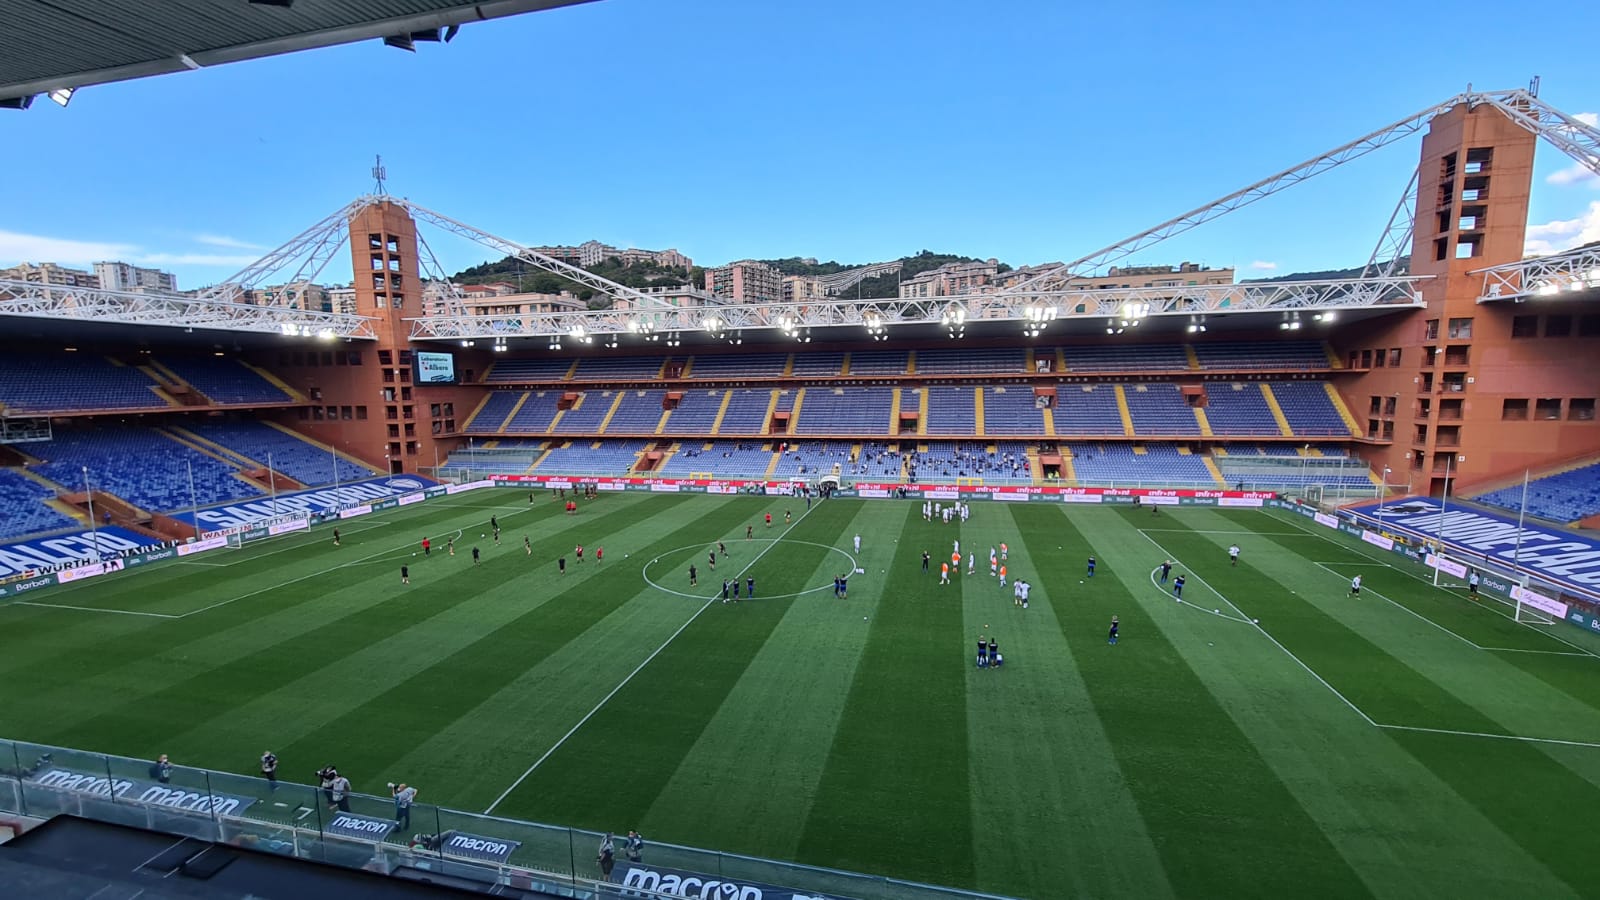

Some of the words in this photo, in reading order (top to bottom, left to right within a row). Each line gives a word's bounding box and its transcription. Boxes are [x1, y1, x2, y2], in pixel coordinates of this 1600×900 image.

[197, 482, 403, 527] SAMPDORIA
[38, 558, 91, 575] WÜRTH
[38, 769, 133, 798] macron
[138, 786, 240, 815] macron
[332, 815, 388, 834] macron
[450, 835, 508, 855] macron
[623, 867, 763, 900] macron
